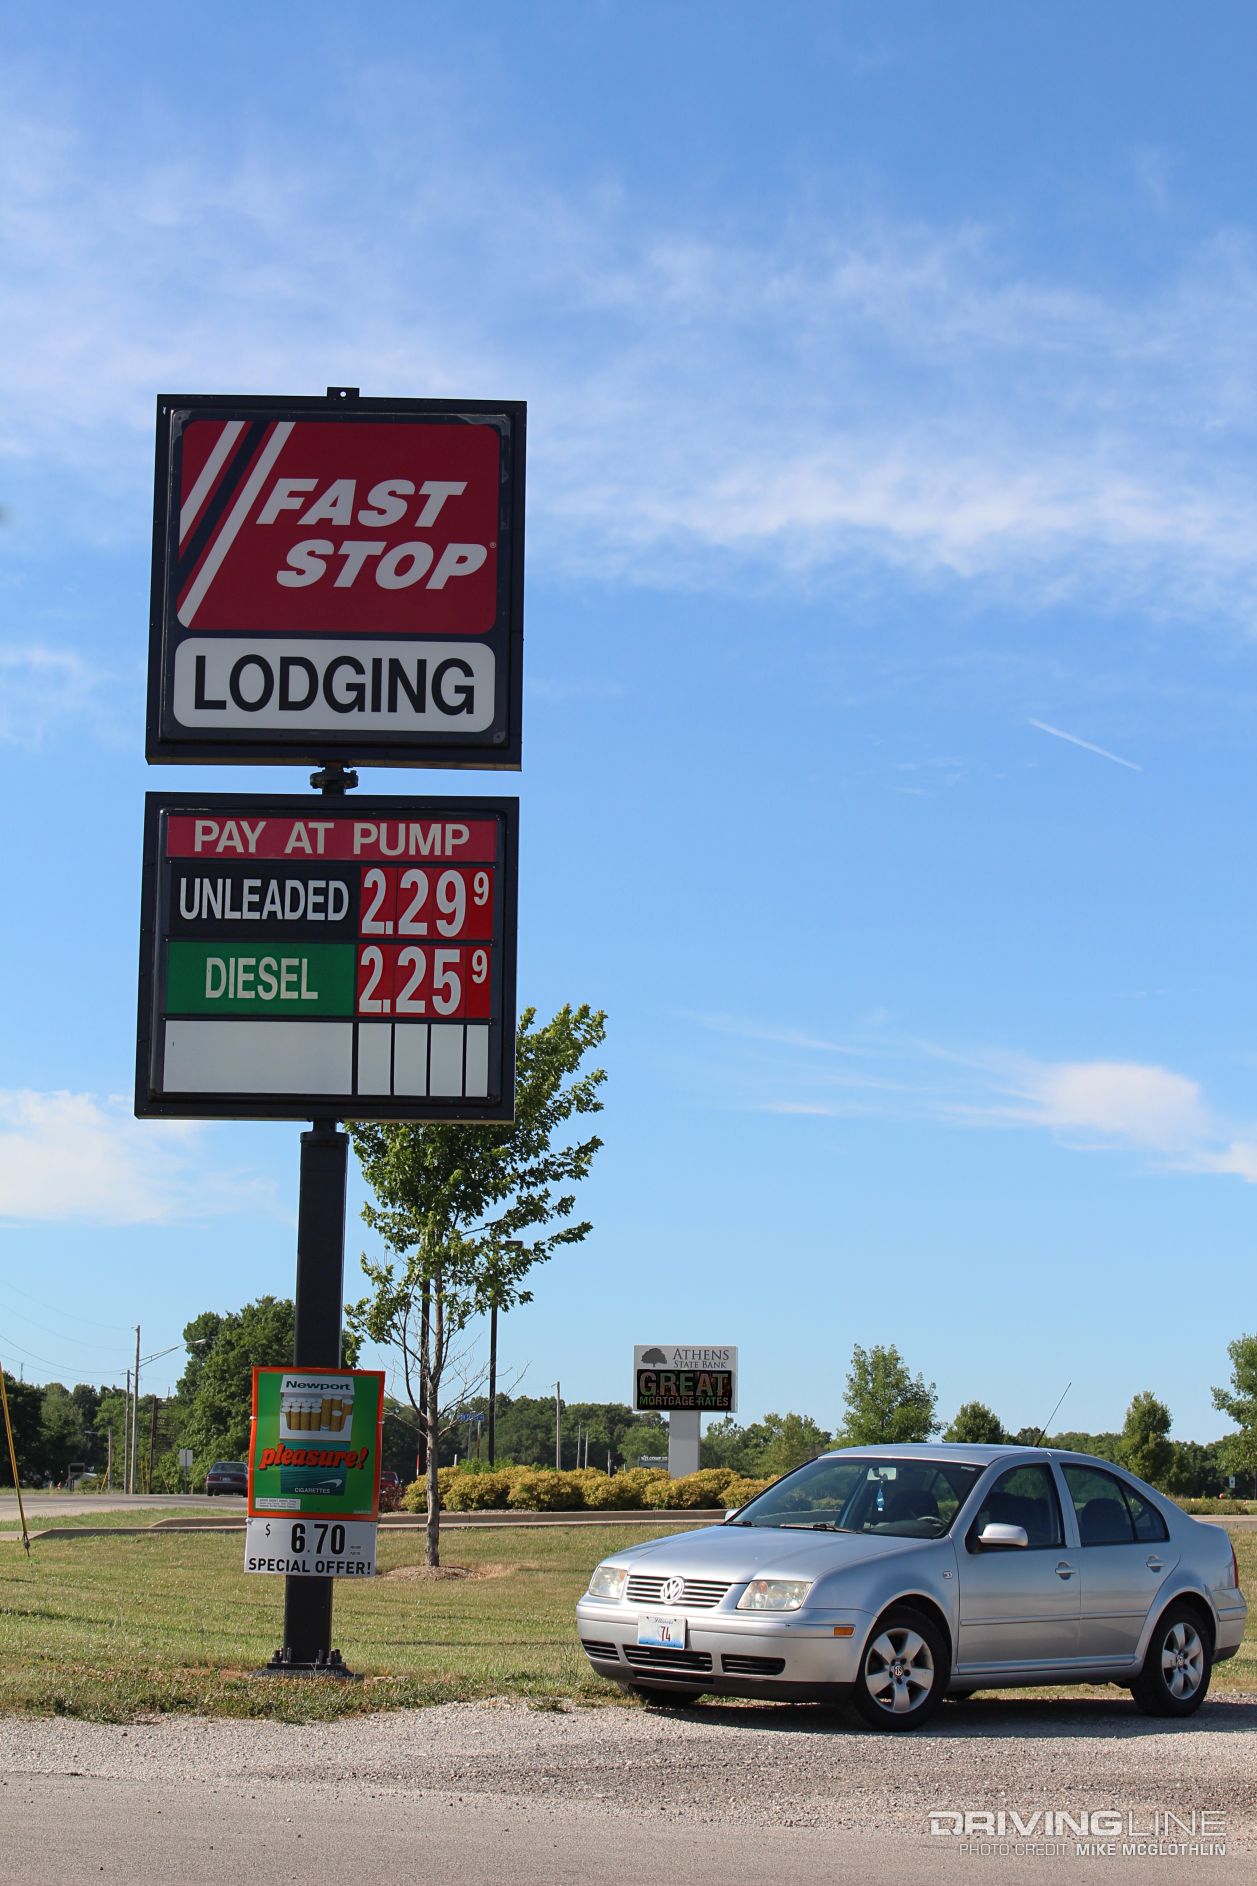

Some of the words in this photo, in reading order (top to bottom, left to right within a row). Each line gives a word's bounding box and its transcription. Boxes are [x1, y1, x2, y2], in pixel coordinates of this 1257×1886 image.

[256, 478, 468, 528] FAST
[276, 539, 488, 590] STOP
[194, 654, 475, 716] LODGING
[194, 820, 267, 853] PAY
[284, 821, 334, 854] AT
[353, 823, 470, 855] PUMP
[179, 877, 349, 921] UNLEADED
[205, 957, 318, 1000] DIESEL
[673, 1348, 729, 1361] ATHENS
[674, 1361, 699, 1369] STATE
[702, 1361, 727, 1369] BANK
[286, 1380, 351, 1391] Newport
[640, 1372, 729, 1396] GREAT
[640, 1396, 694, 1406] MORTGAGE
[698, 1397, 729, 1407] RATES
[258, 1443, 369, 1471] pleasure!
[265, 1522, 271, 1538] $
[291, 1523, 346, 1555] 6.70
[248, 1557, 310, 1573] SPECIAL
[315, 1560, 371, 1575] OFFER!
[660, 1625, 671, 1642] 74
